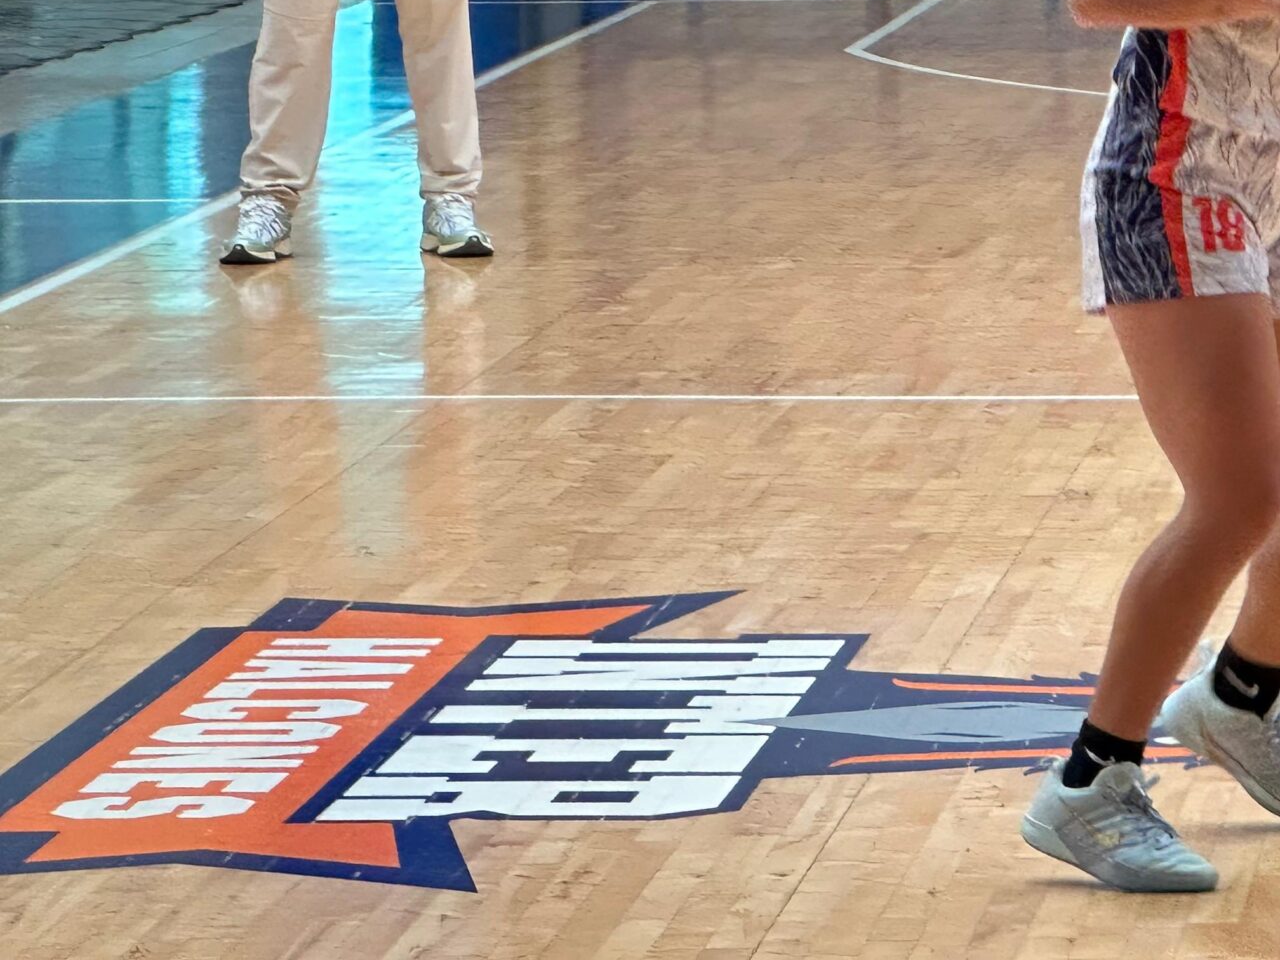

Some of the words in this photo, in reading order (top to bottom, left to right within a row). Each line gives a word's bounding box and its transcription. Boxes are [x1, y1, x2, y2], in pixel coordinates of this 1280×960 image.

[1191, 193, 1246, 254] 18
[50, 637, 444, 820] HALCONES
[315, 638, 846, 821] INTER
